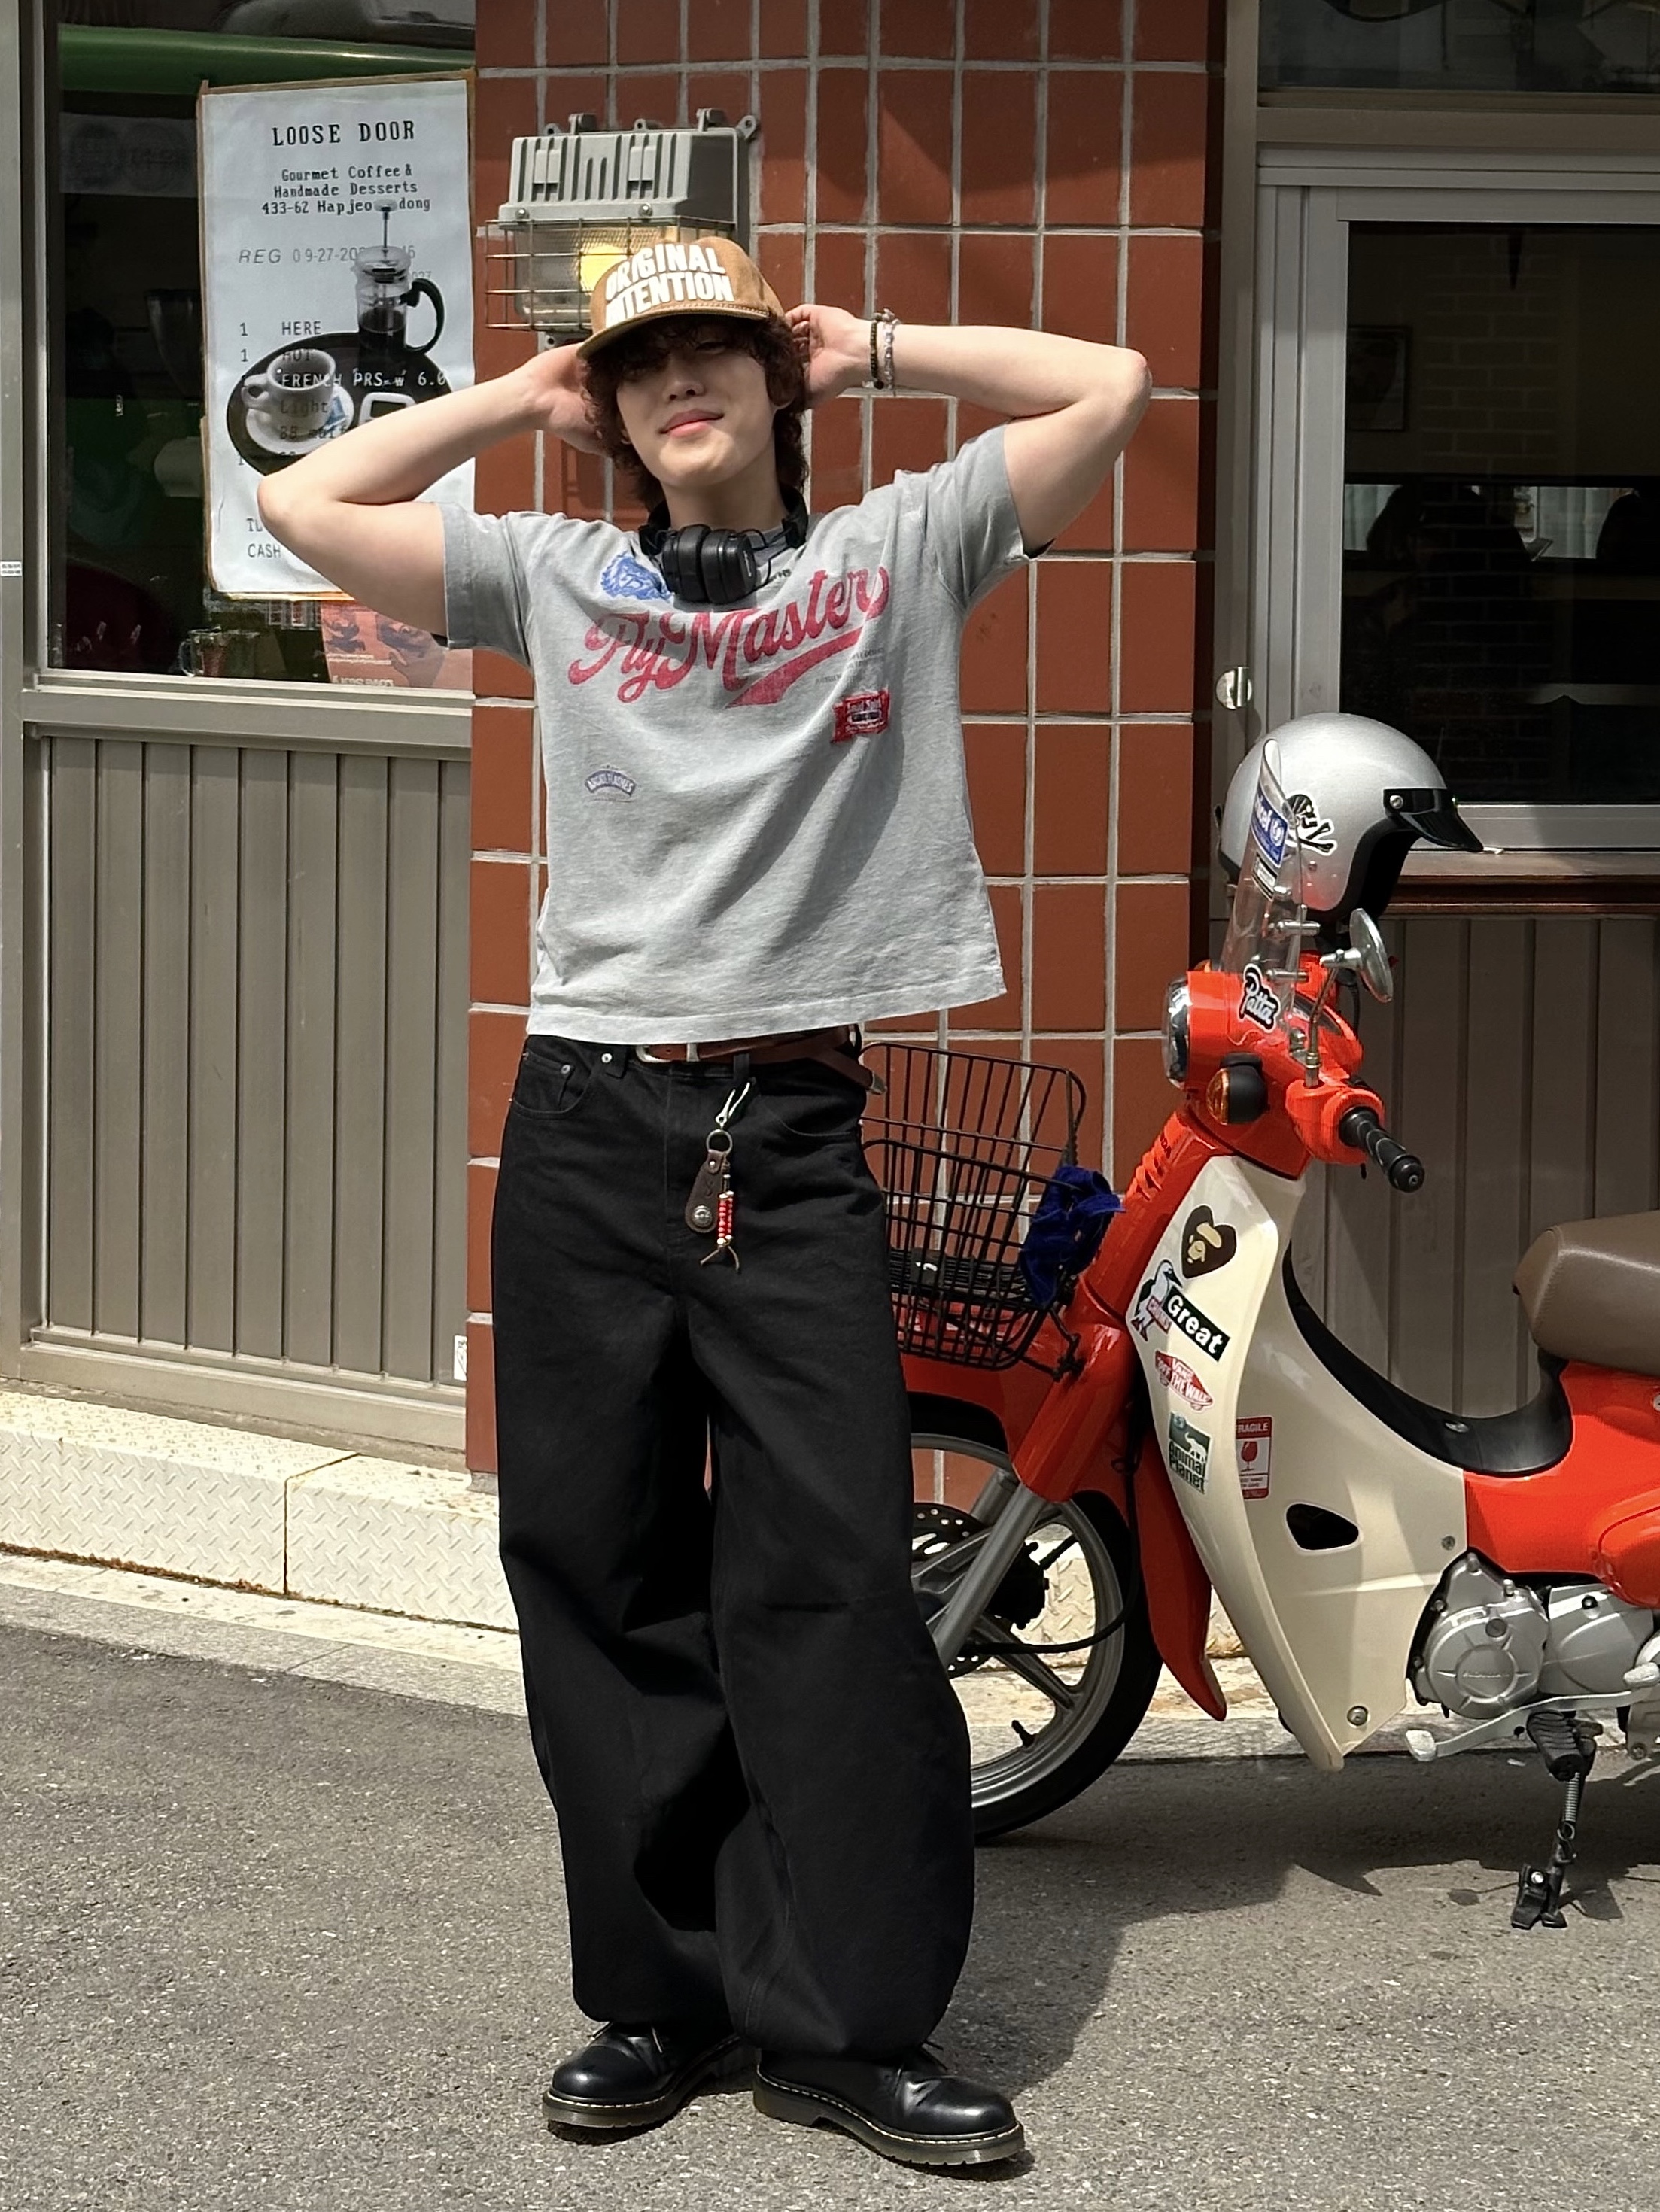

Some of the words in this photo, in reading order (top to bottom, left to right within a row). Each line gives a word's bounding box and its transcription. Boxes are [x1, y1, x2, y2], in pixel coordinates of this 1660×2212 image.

[272, 125, 341, 146] LOOSE
[358, 120, 415, 142] DOOR
[281, 167, 339, 181] Gourmet
[348, 165, 401, 179] Coffee
[405, 164, 412, 177] &
[274, 184, 339, 199] Handmade
[350, 181, 418, 196] Desserts
[261, 201, 309, 214] 433-62
[239, 249, 281, 263] REG
[605, 243, 726, 301] ORIGINAL
[239, 322, 248, 336] 1
[281, 321, 321, 336] HERE
[240, 348, 249, 362] 1
[281, 372, 342, 388] FRENCH
[248, 542, 281, 558] CASH
[1167, 1295, 1223, 1354] Great
